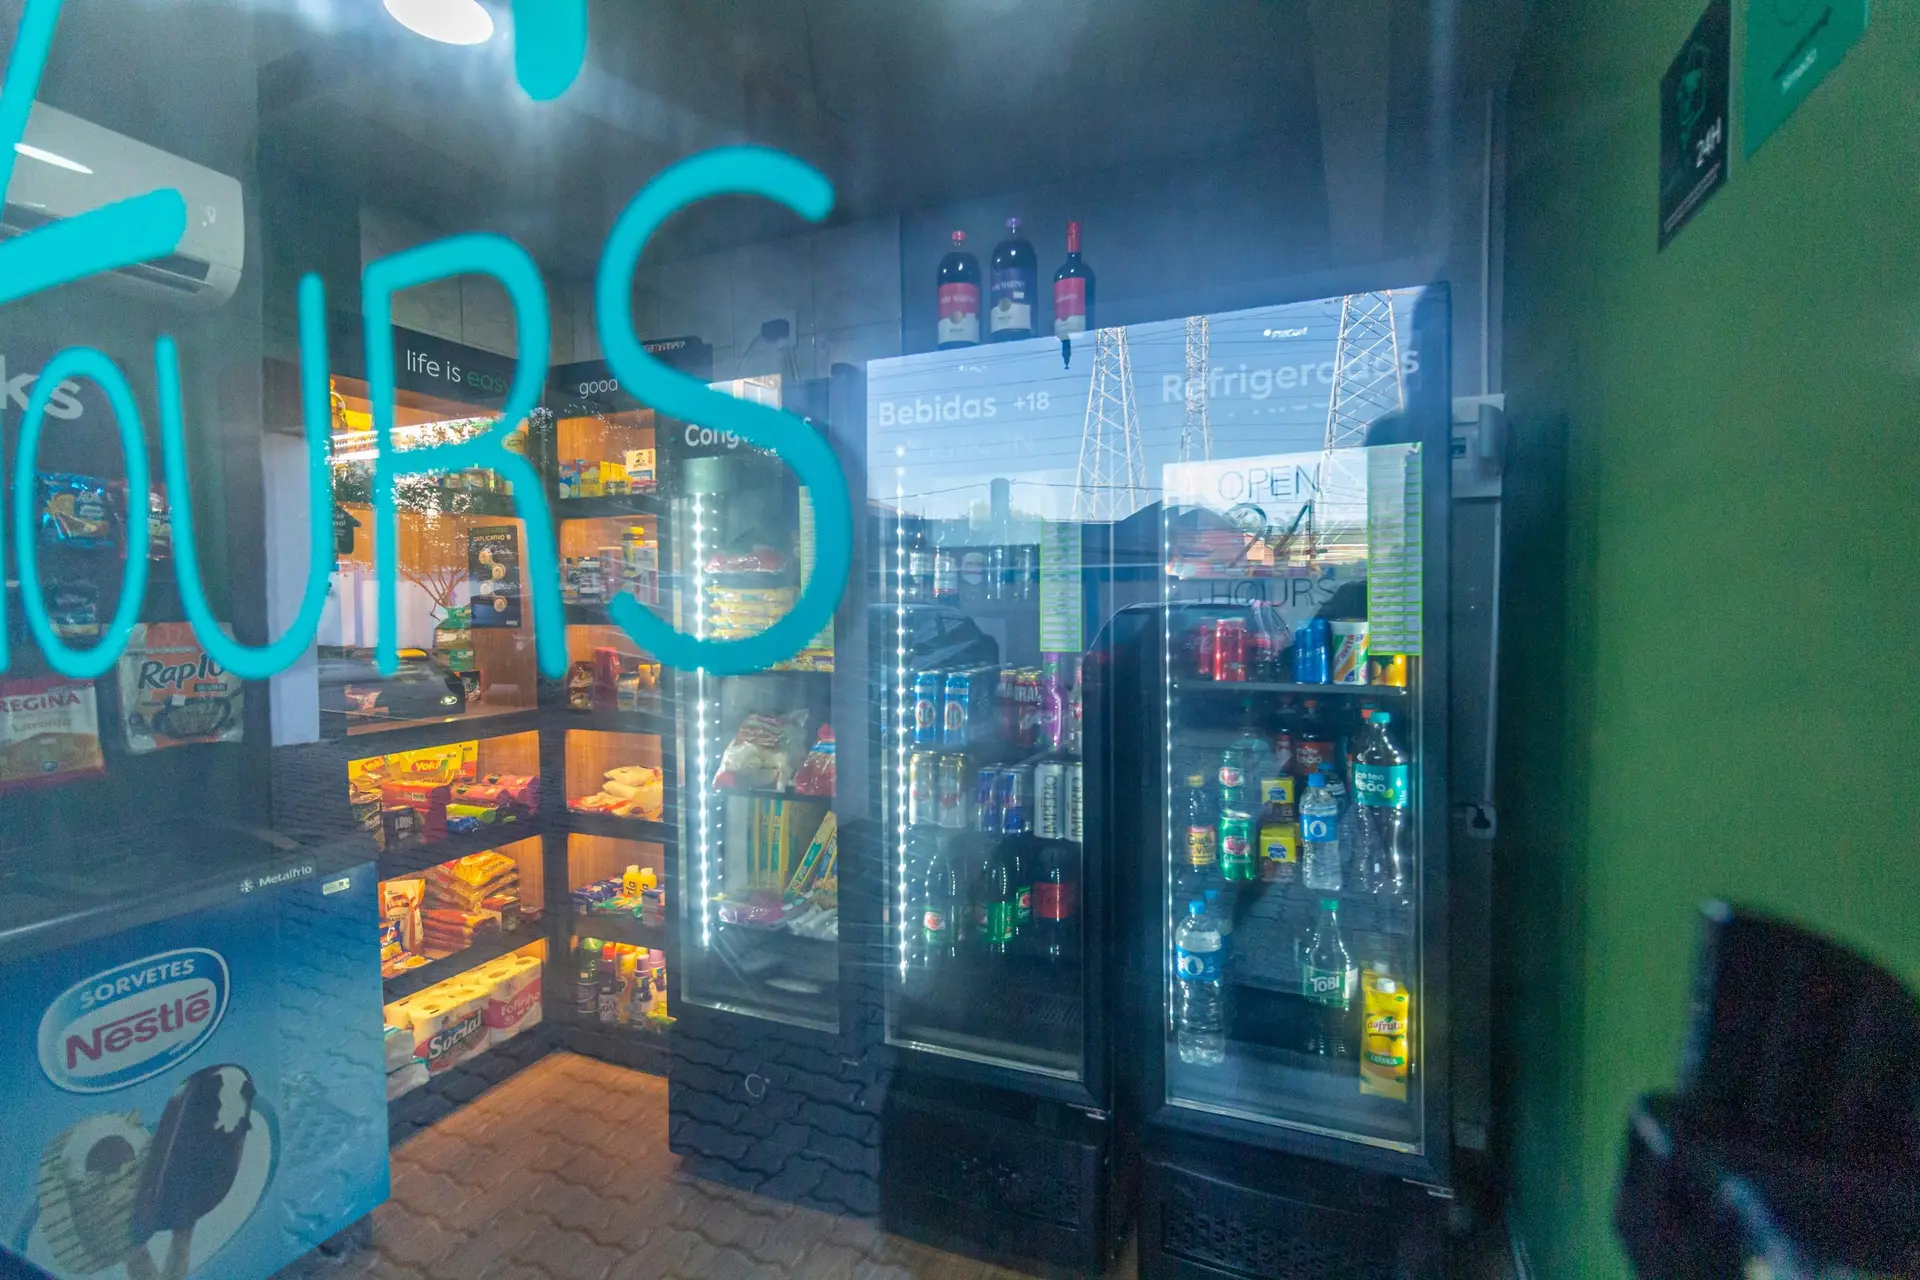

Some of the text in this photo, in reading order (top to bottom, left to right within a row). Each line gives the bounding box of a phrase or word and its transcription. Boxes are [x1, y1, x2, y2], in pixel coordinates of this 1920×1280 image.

[406, 349, 439, 378] life
[446, 361, 461, 383] is
[0, 145, 852, 682] OURS
[878, 390, 1051, 427] Bebidas +18
[684, 422, 741, 450] Cong
[1217, 463, 1322, 502] OPEN
[1224, 501, 1317, 569] 24
[1208, 576, 1337, 609] HOURS
[415, 760, 443, 772] Yoki
[259, 865, 313, 887] Metalfrio
[80, 958, 196, 1009] SORVETES
[1310, 975, 1341, 993] TOBI
[428, 1007, 483, 1060] Social
[1367, 1018, 1405, 1033] dafruta
